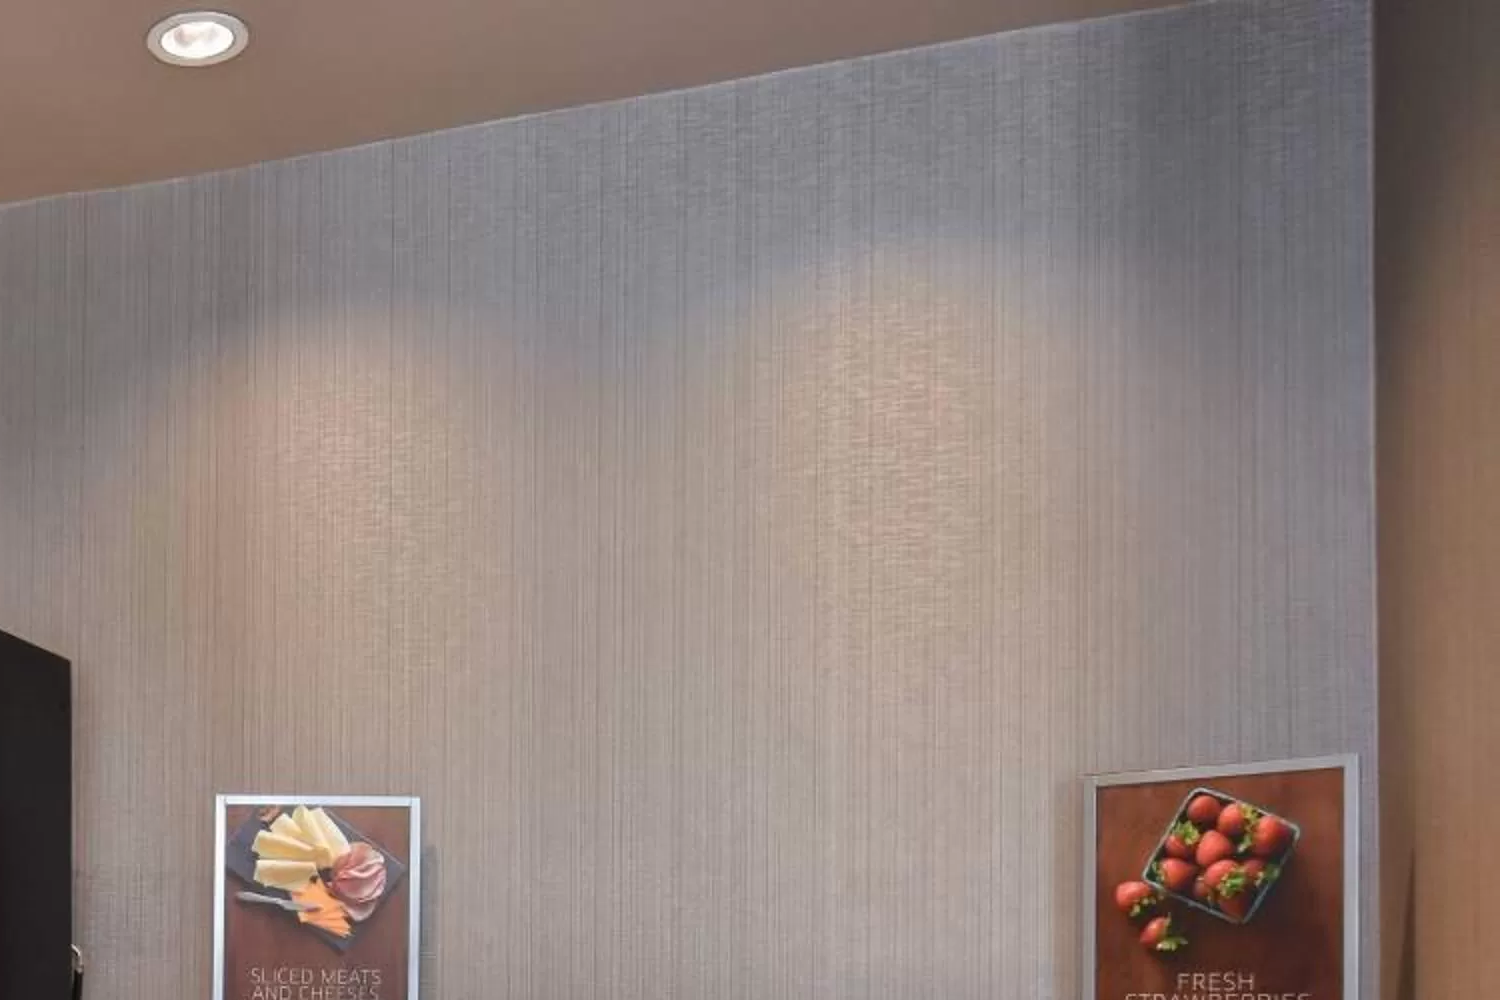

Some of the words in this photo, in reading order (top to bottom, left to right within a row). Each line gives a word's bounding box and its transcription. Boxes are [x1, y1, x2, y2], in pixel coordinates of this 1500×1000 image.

[251, 967, 314, 985] SLICED
[321, 968, 382, 985] MEATS
[1176, 973, 1255, 992] FRESH
[251, 985, 293, 1000] AND
